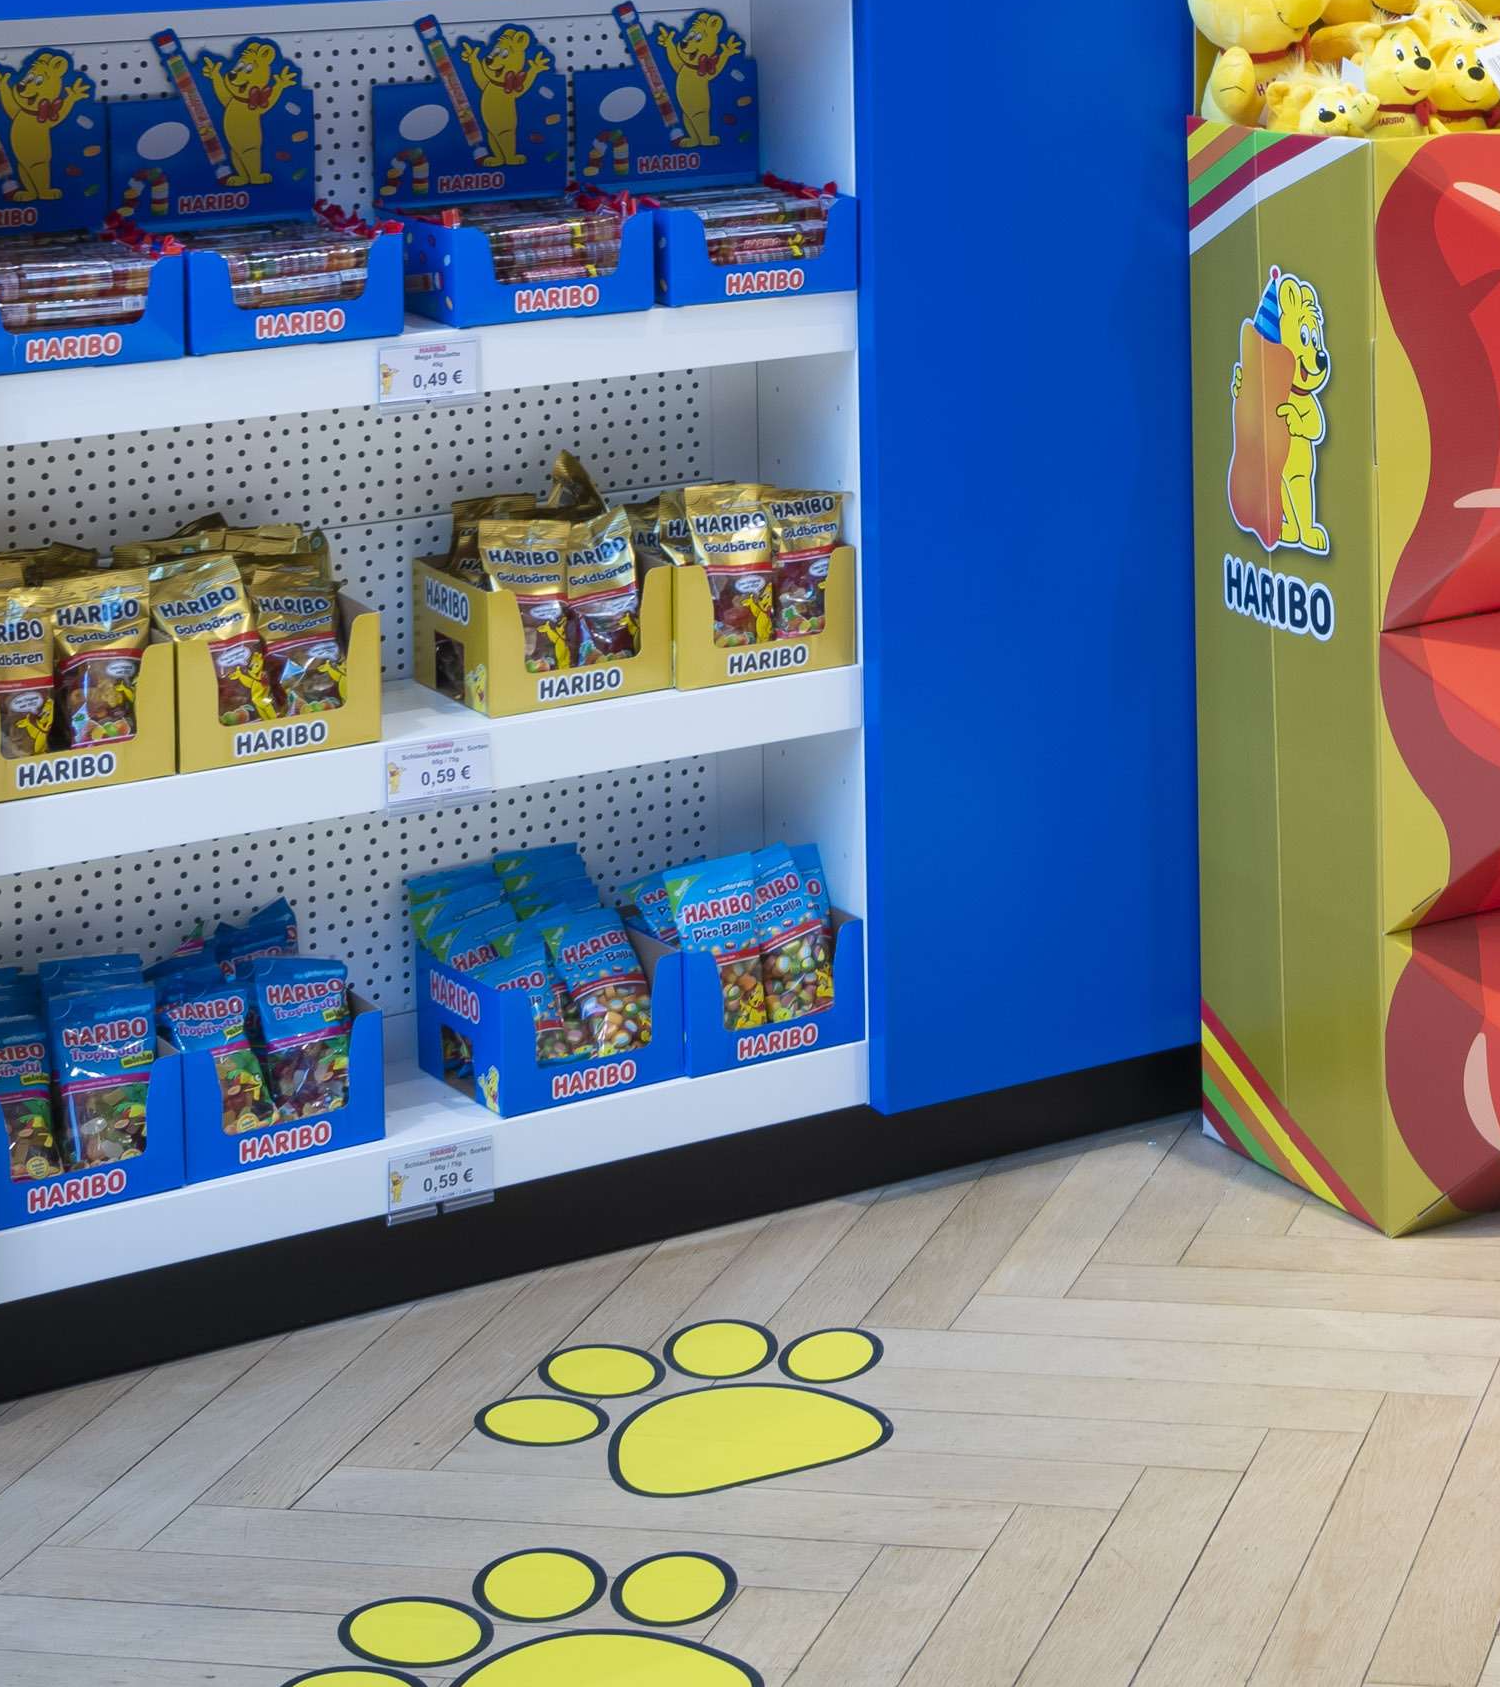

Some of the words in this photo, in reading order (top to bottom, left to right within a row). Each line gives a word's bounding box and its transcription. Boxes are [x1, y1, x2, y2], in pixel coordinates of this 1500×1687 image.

[637, 153, 700, 174] HARIBO
[438, 172, 505, 194] HARIBO
[179, 192, 250, 213] HARIBO
[726, 269, 805, 296] HARIBO
[515, 285, 599, 314] HARIBO
[256, 309, 345, 339] HARIBO
[26, 333, 122, 363] HARIBO
[413, 372, 447, 390] 0,49
[452, 370, 462, 384] €
[770, 497, 835, 520] HARIBO
[695, 512, 766, 534] HARIBO
[488, 549, 560, 567] HARIBO
[703, 538, 766, 553] Goldbären
[496, 570, 561, 583] Goldbären
[569, 560, 633, 586] Goldbären
[159, 586, 237, 618] HARIBO
[257, 595, 331, 614] HARIBO
[424, 577, 470, 624] HARIBO
[1224, 555, 1334, 639] HARIBO
[56, 599, 139, 626] HARIBO
[175, 613, 243, 636] Goldbären
[267, 614, 332, 633] Goldbären
[66, 627, 138, 645] Goldbären
[728, 645, 808, 675] HARIBO
[538, 669, 622, 700] HARIBO
[236, 721, 326, 756] HARIBO
[17, 753, 114, 787] HARIBO
[421, 768, 455, 787] 0,59
[461, 765, 471, 779] €
[684, 894, 753, 924] HARIBO
[267, 978, 343, 1006] HARIBO
[430, 970, 480, 1024] HARIBO
[169, 997, 244, 1019] HARIBO
[63, 1018, 147, 1047] HARIBO
[738, 1024, 818, 1061] HARIBO
[553, 1060, 636, 1100] HARIBO
[240, 1122, 333, 1164] HARIBO
[28, 1170, 126, 1213] HARIBO
[423, 1172, 458, 1192] 0,59
[463, 1168, 473, 1183] €
